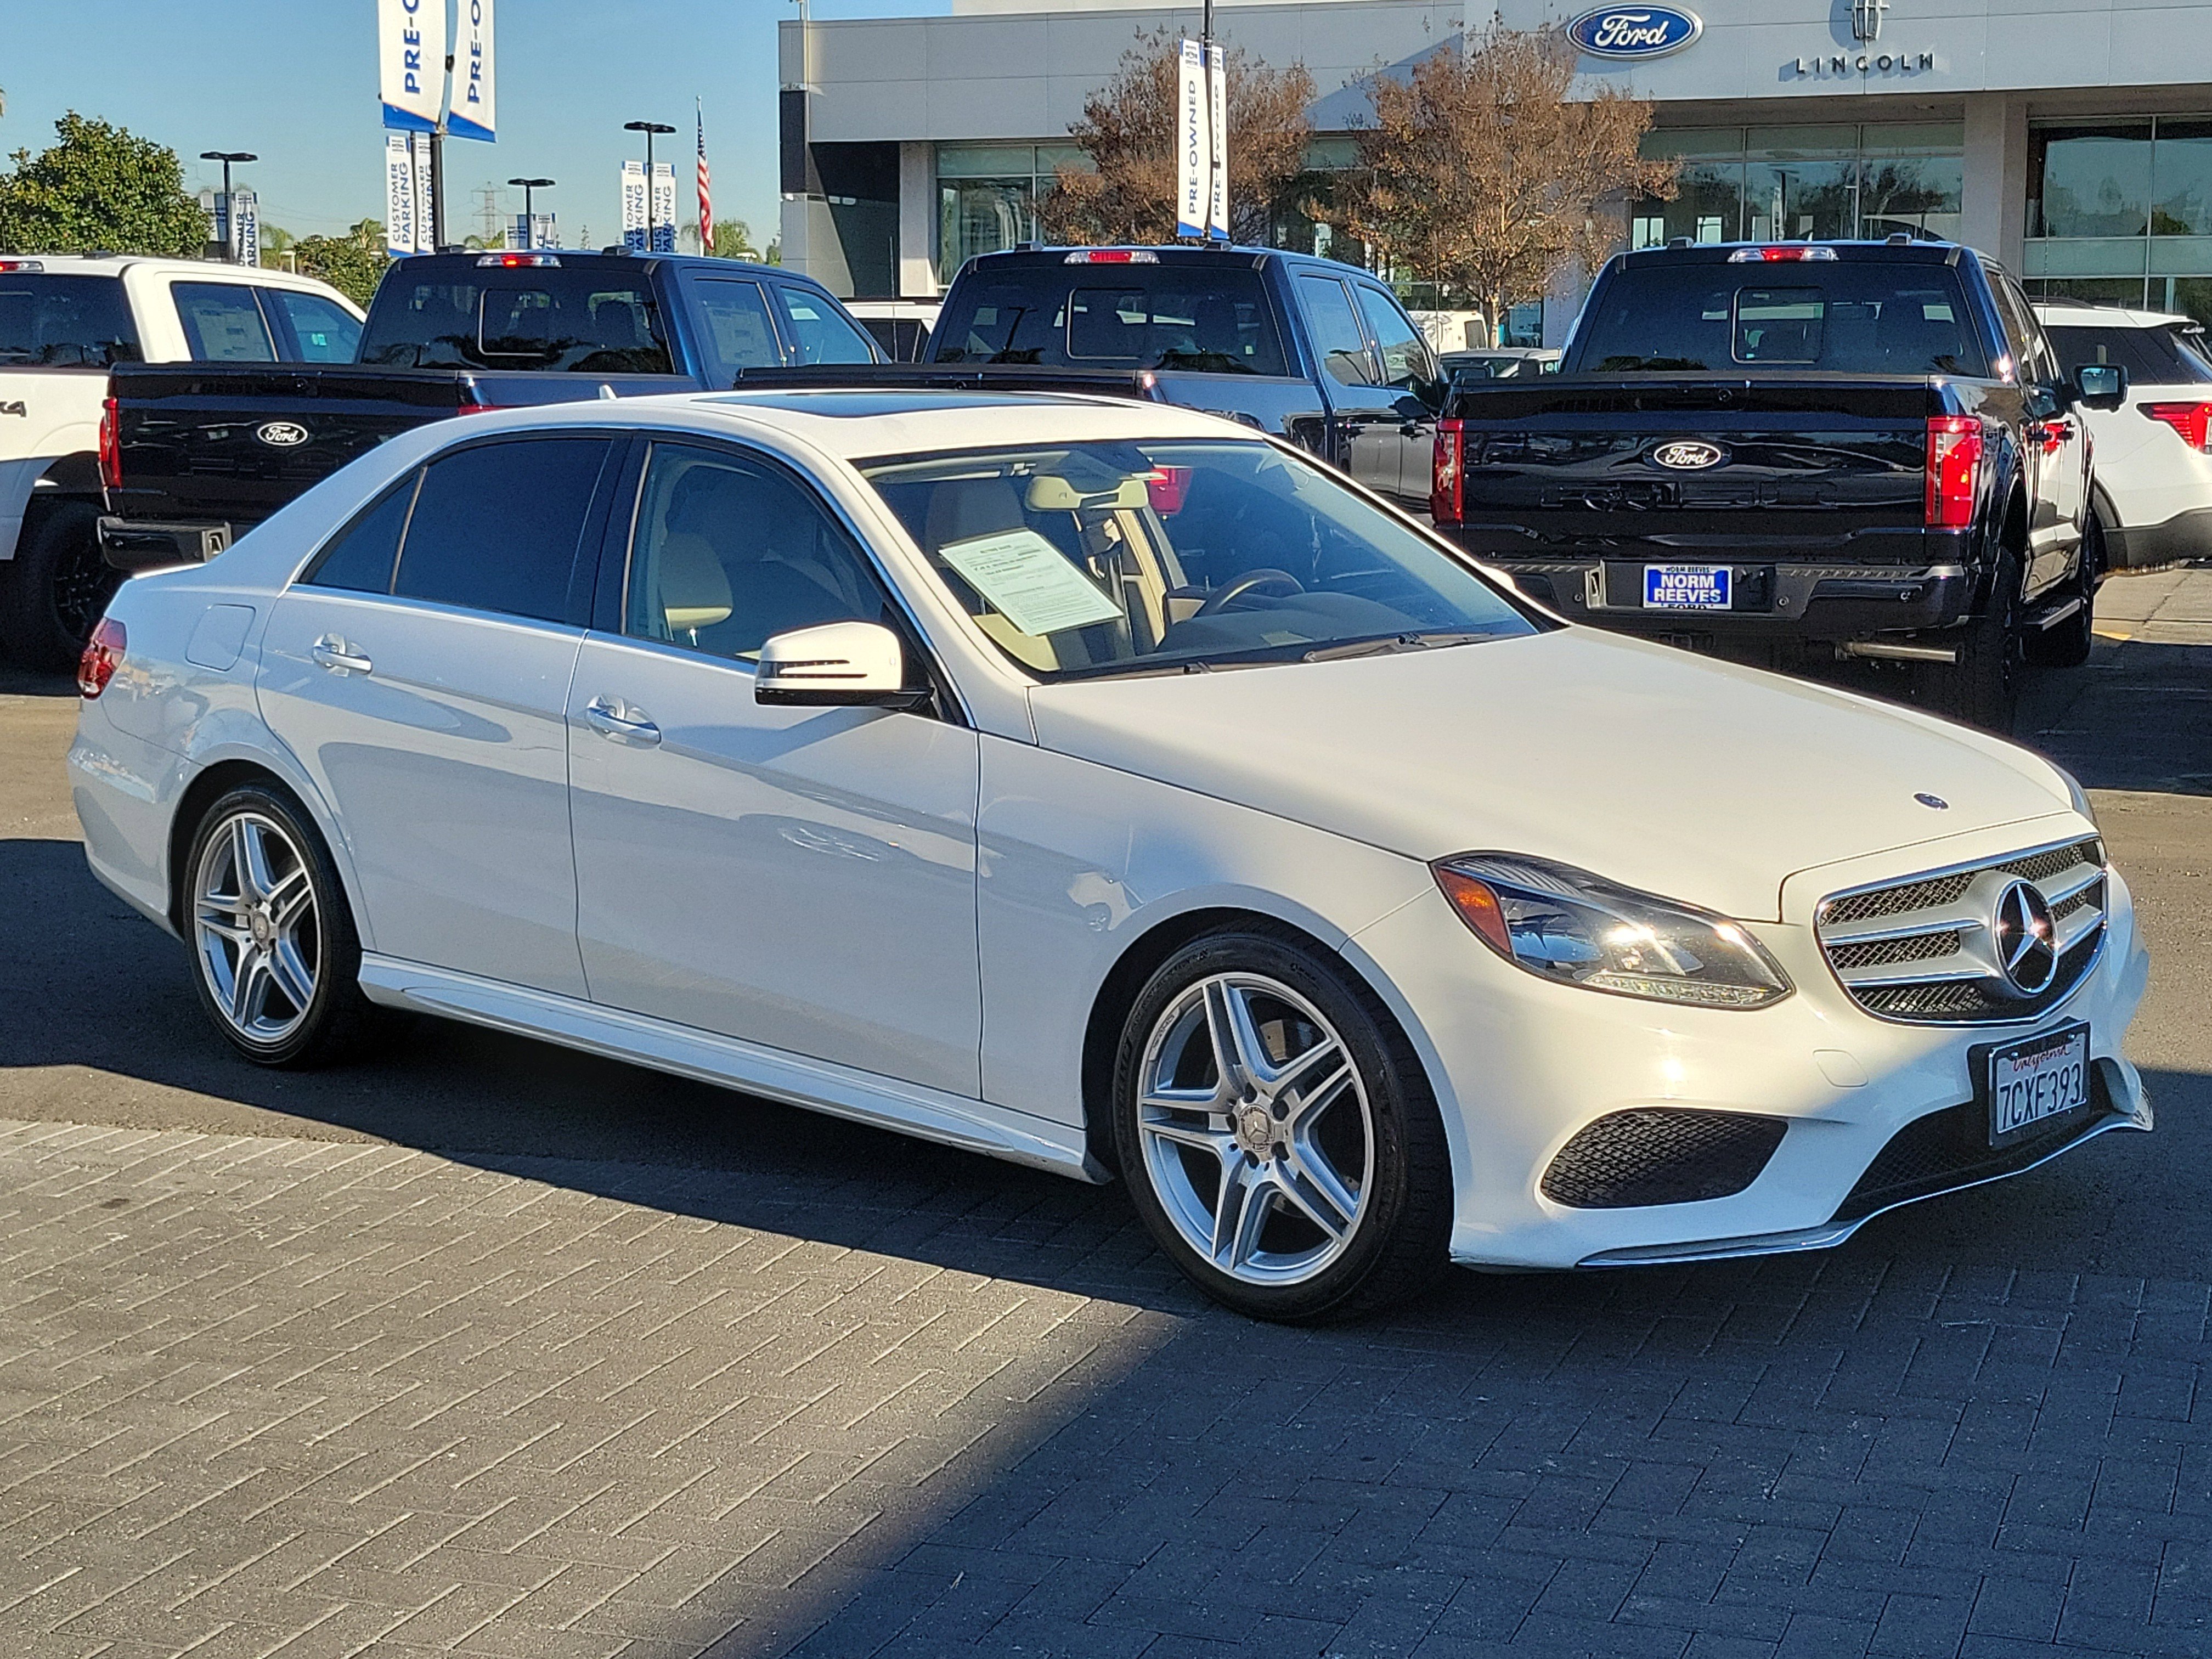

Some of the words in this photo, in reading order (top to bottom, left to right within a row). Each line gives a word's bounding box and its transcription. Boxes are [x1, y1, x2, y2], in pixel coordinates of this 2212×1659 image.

[1594, 14, 1669, 47] Ford
[1796, 53, 1933, 74] LINCOLN
[1188, 81, 1198, 214] PRE-OWNED
[391, 163, 400, 242] CUSTOMER
[399, 162, 411, 244] PARKING
[626, 185, 634, 250] USTOMER
[245, 211, 256, 267] ARKING
[266, 426, 298, 442] Ford
[1666, 446, 1709, 465] Ford
[1654, 589, 1722, 602] REEVES
[1661, 575, 1714, 588] NORM
[2000, 1063, 2080, 1129] 7CXF393
